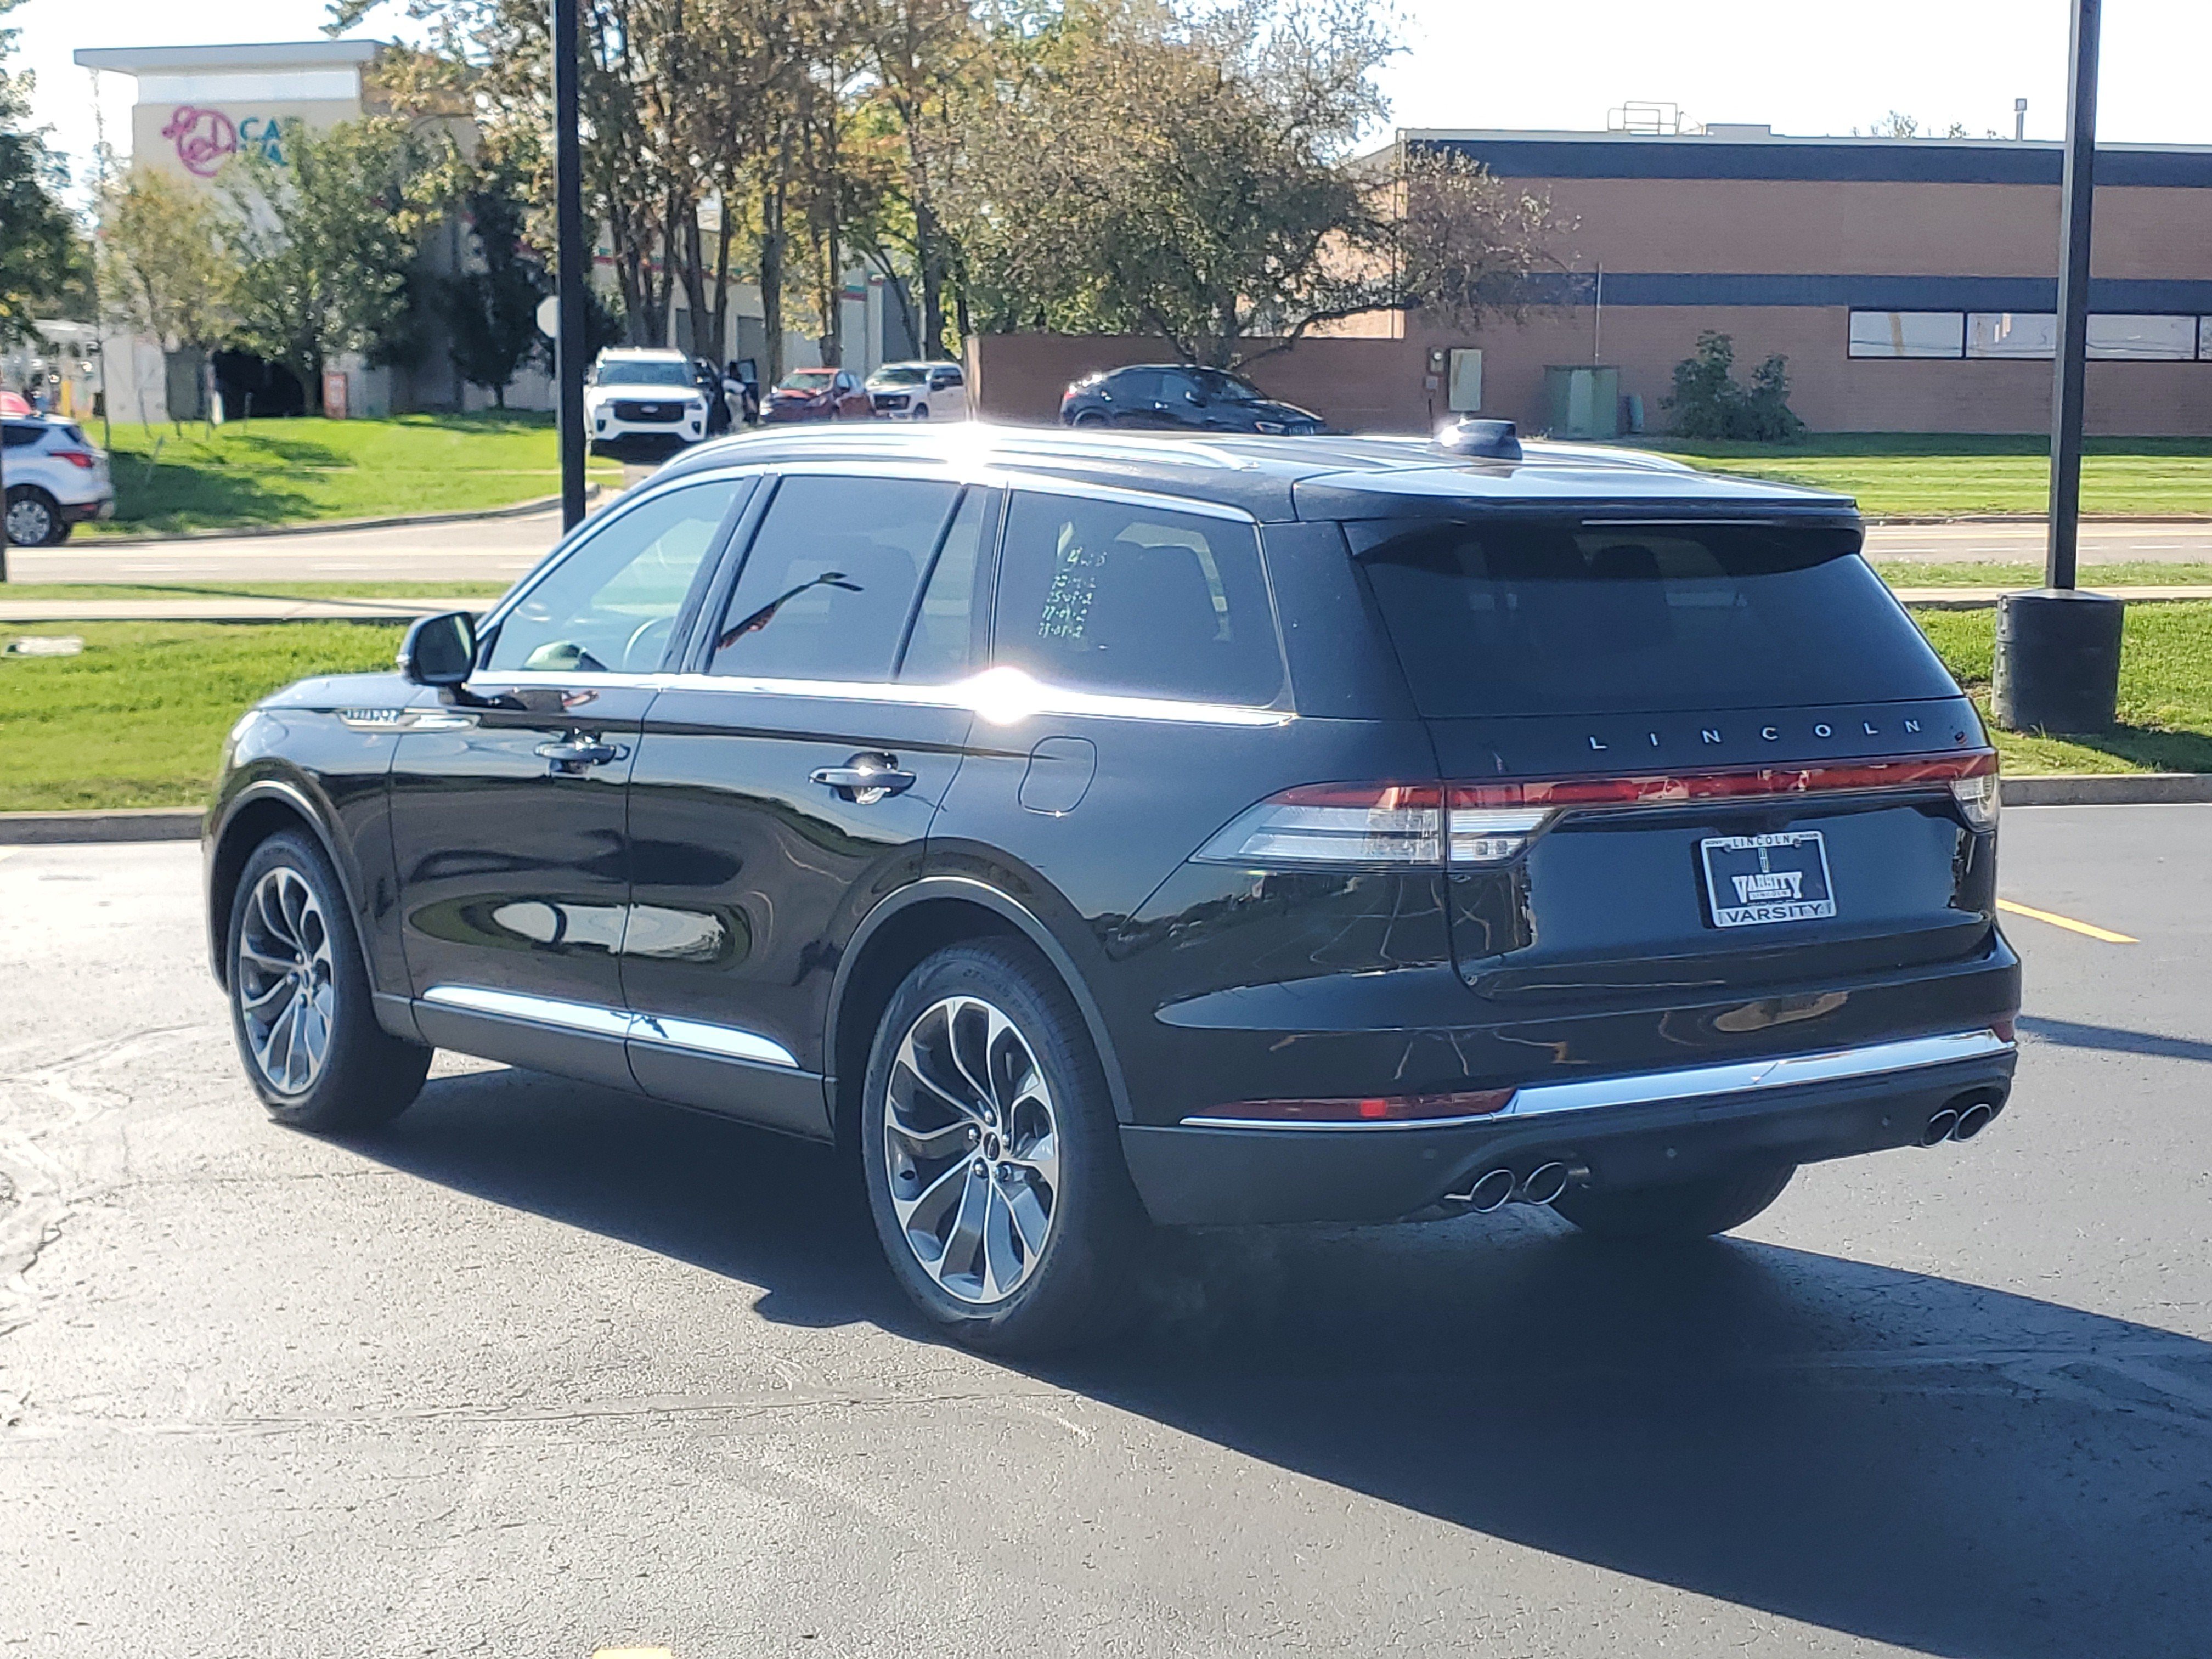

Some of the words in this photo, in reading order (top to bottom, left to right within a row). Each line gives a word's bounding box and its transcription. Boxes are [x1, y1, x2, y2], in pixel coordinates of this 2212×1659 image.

[1590, 719, 1921, 751] LINCOLN
[1733, 834, 1790, 848] LINCOLN
[1731, 871, 1802, 904] VARSITY
[1726, 903, 1822, 923] VARSITY
